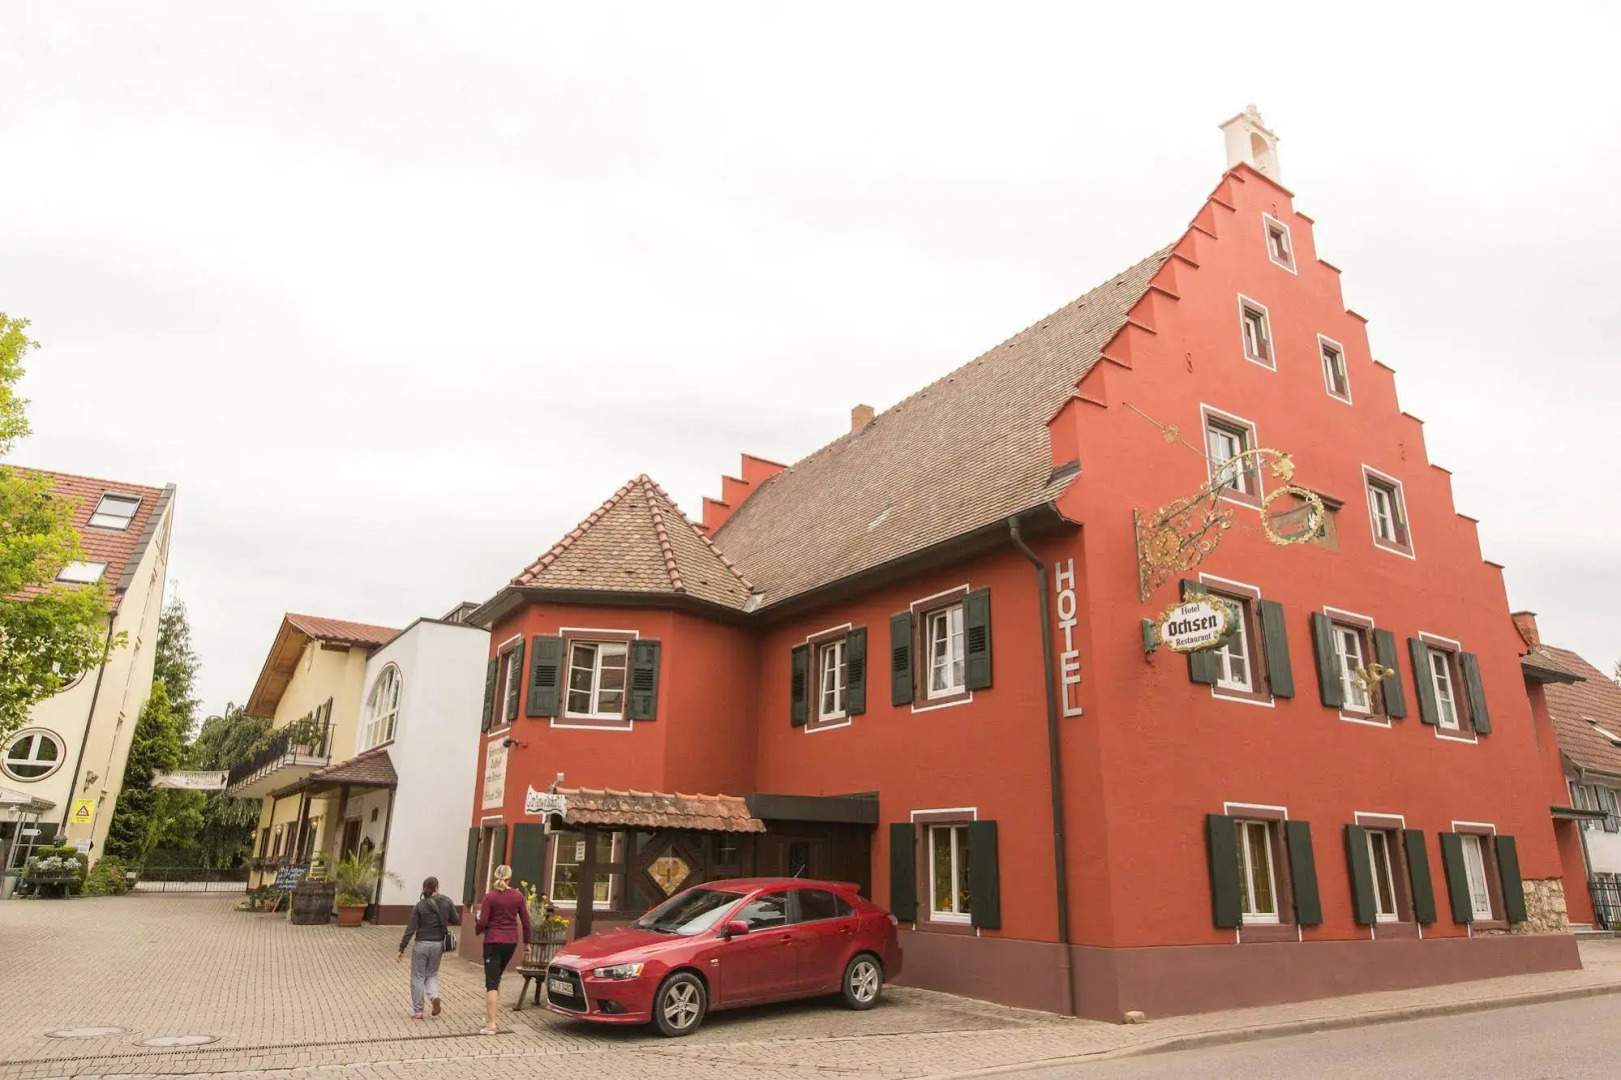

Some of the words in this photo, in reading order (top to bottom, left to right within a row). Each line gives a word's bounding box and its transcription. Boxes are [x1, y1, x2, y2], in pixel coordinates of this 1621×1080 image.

[1181, 604, 1200, 615] Hotel
[1168, 615, 1217, 636] Ochsen
[1055, 558, 1082, 717] HOTEL
[1175, 632, 1211, 646] Restaurant
